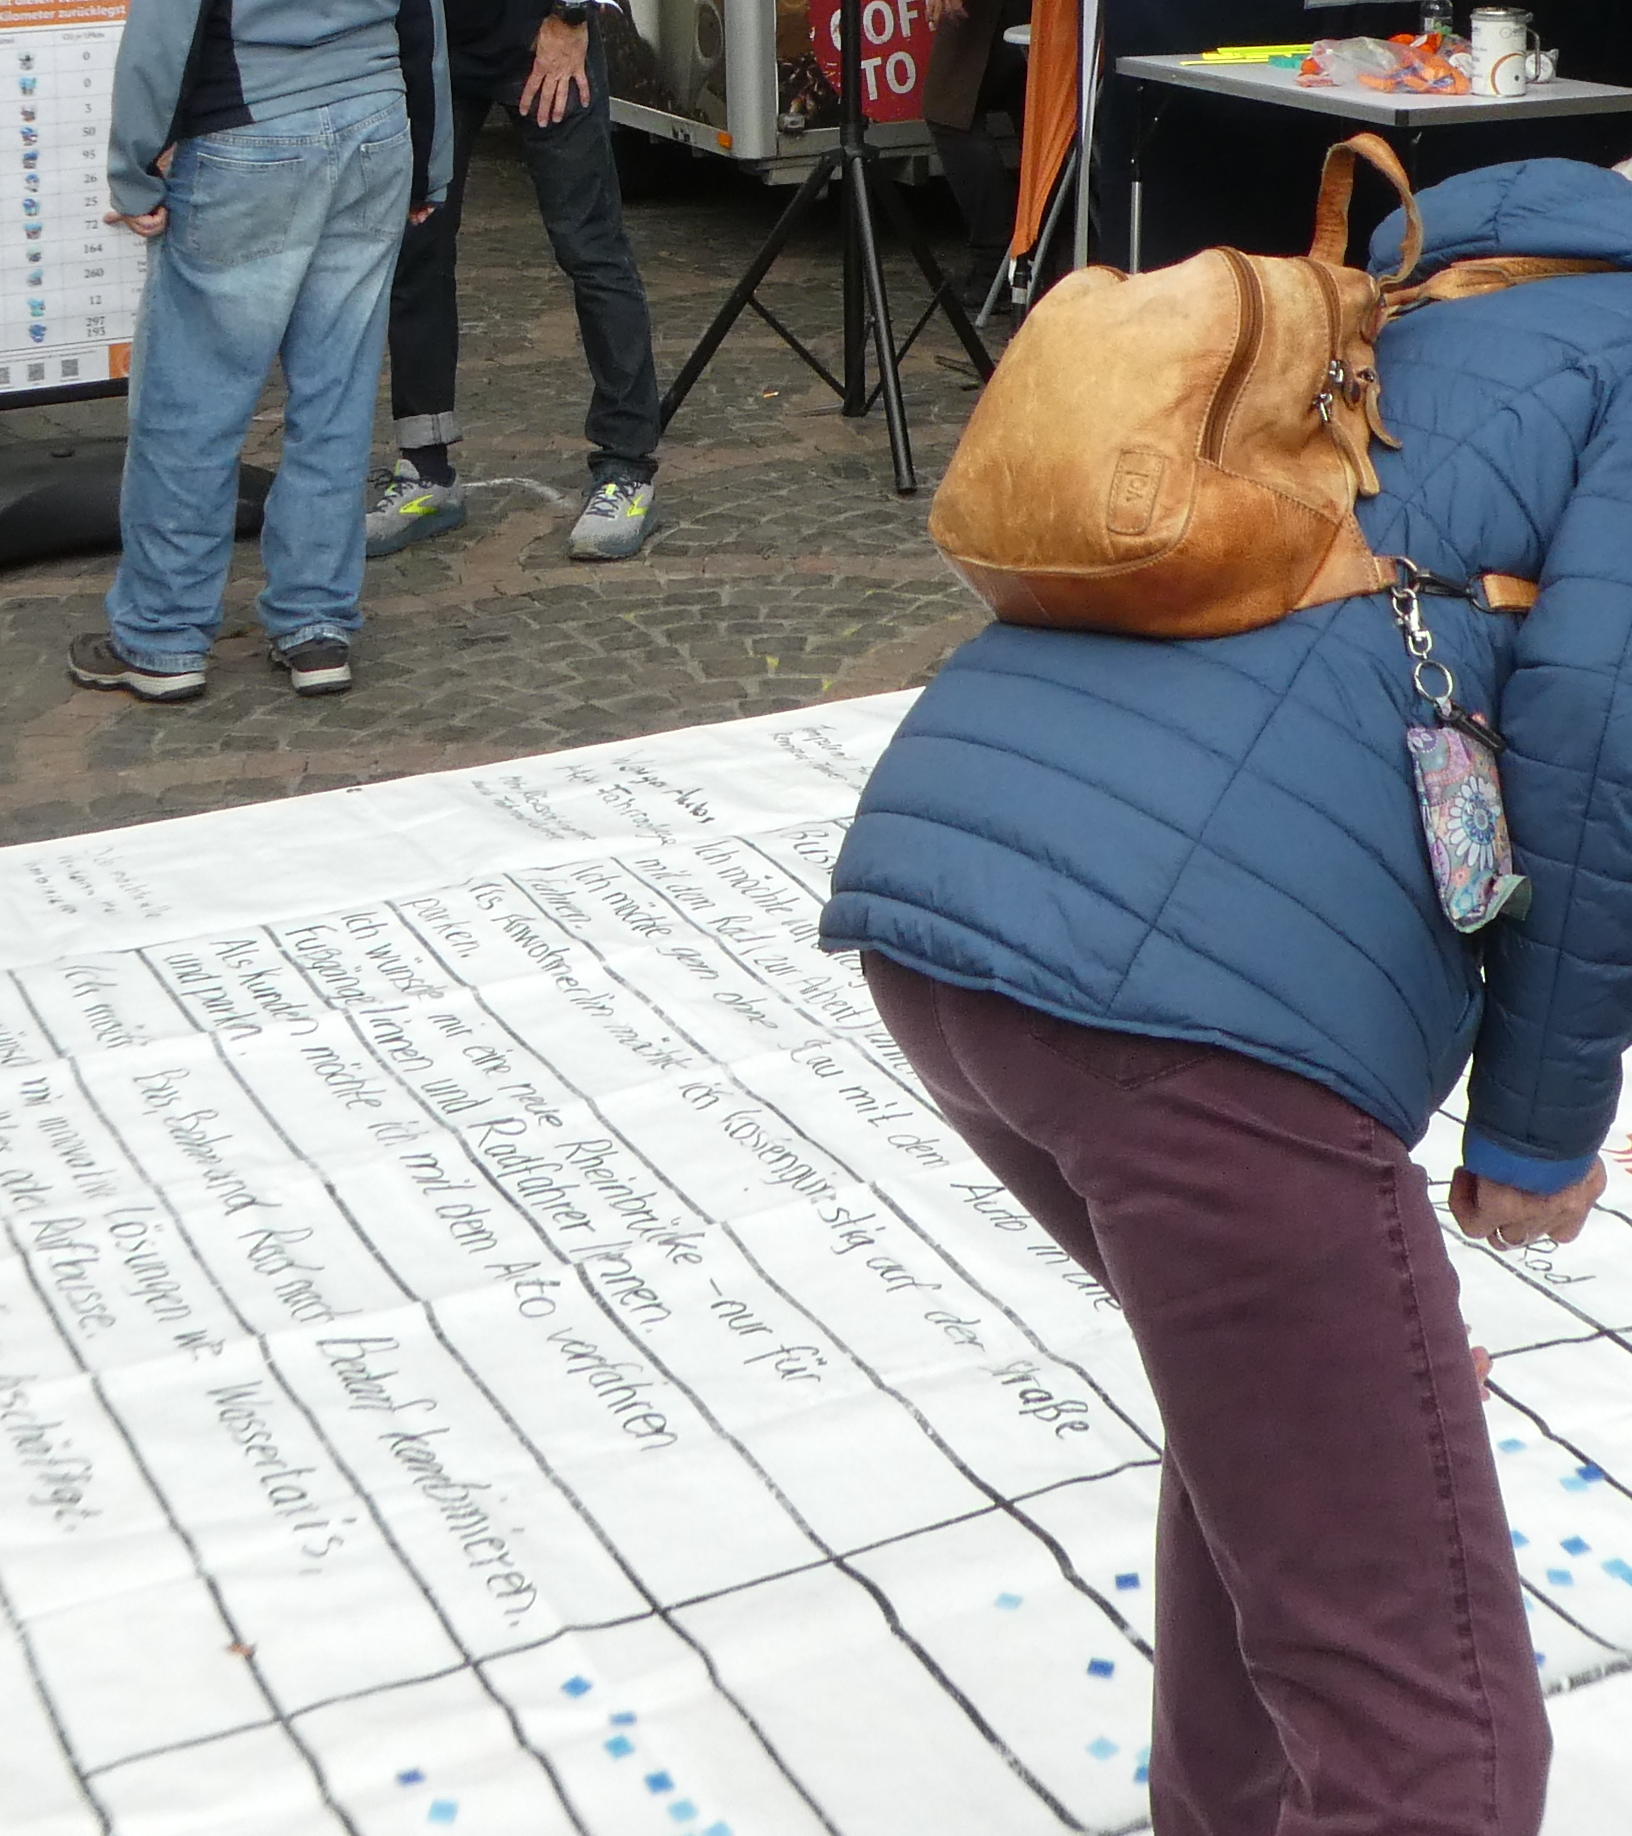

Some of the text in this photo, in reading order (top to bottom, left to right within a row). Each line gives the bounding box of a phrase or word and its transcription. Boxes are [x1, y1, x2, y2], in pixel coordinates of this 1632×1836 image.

[58, 5, 126, 19] zurücklegst
[82, 51, 91, 61] 0
[83, 78, 92, 88] 0
[861, 50, 917, 101] TO
[82, 149, 96, 160] 95
[84, 173, 98, 184] 26
[85, 197, 98, 207] 25
[85, 220, 99, 230] 72
[83, 243, 103, 254] 164
[84, 268, 105, 279] 260
[90, 295, 102, 305] 12
[692, 839, 800, 913] Ich möchte
[634, 858, 690, 880] mit
[706, 914, 776, 943] Rad
[400, 897, 479, 958] parken.
[162, 952, 222, 984] und
[208, 939, 259, 969] Als
[569, 864, 621, 893] Ich
[601, 891, 673, 938] möchte
[712, 991, 778, 1029] ohne
[838, 1085, 913, 1128] mit
[886, 1133, 950, 1166] dem
[949, 1182, 1030, 1231] Auto
[300, 1046, 386, 1109] möchte
[420, 1077, 493, 1114] und
[340, 910, 388, 940] Ich
[426, 1013, 485, 1038] mir
[461, 1045, 513, 1076] eine
[496, 1082, 563, 1127] neue
[554, 1138, 705, 1264] Rheinbrücke
[742, 1344, 827, 1382] für
[398, 1152, 476, 1196] mit
[434, 1203, 497, 1254] dem
[84, 1206, 191, 1322] Lösungen
[865, 1256, 942, 1293] auf
[923, 1310, 985, 1352] der
[379, 1427, 536, 1626] kombinieren.
